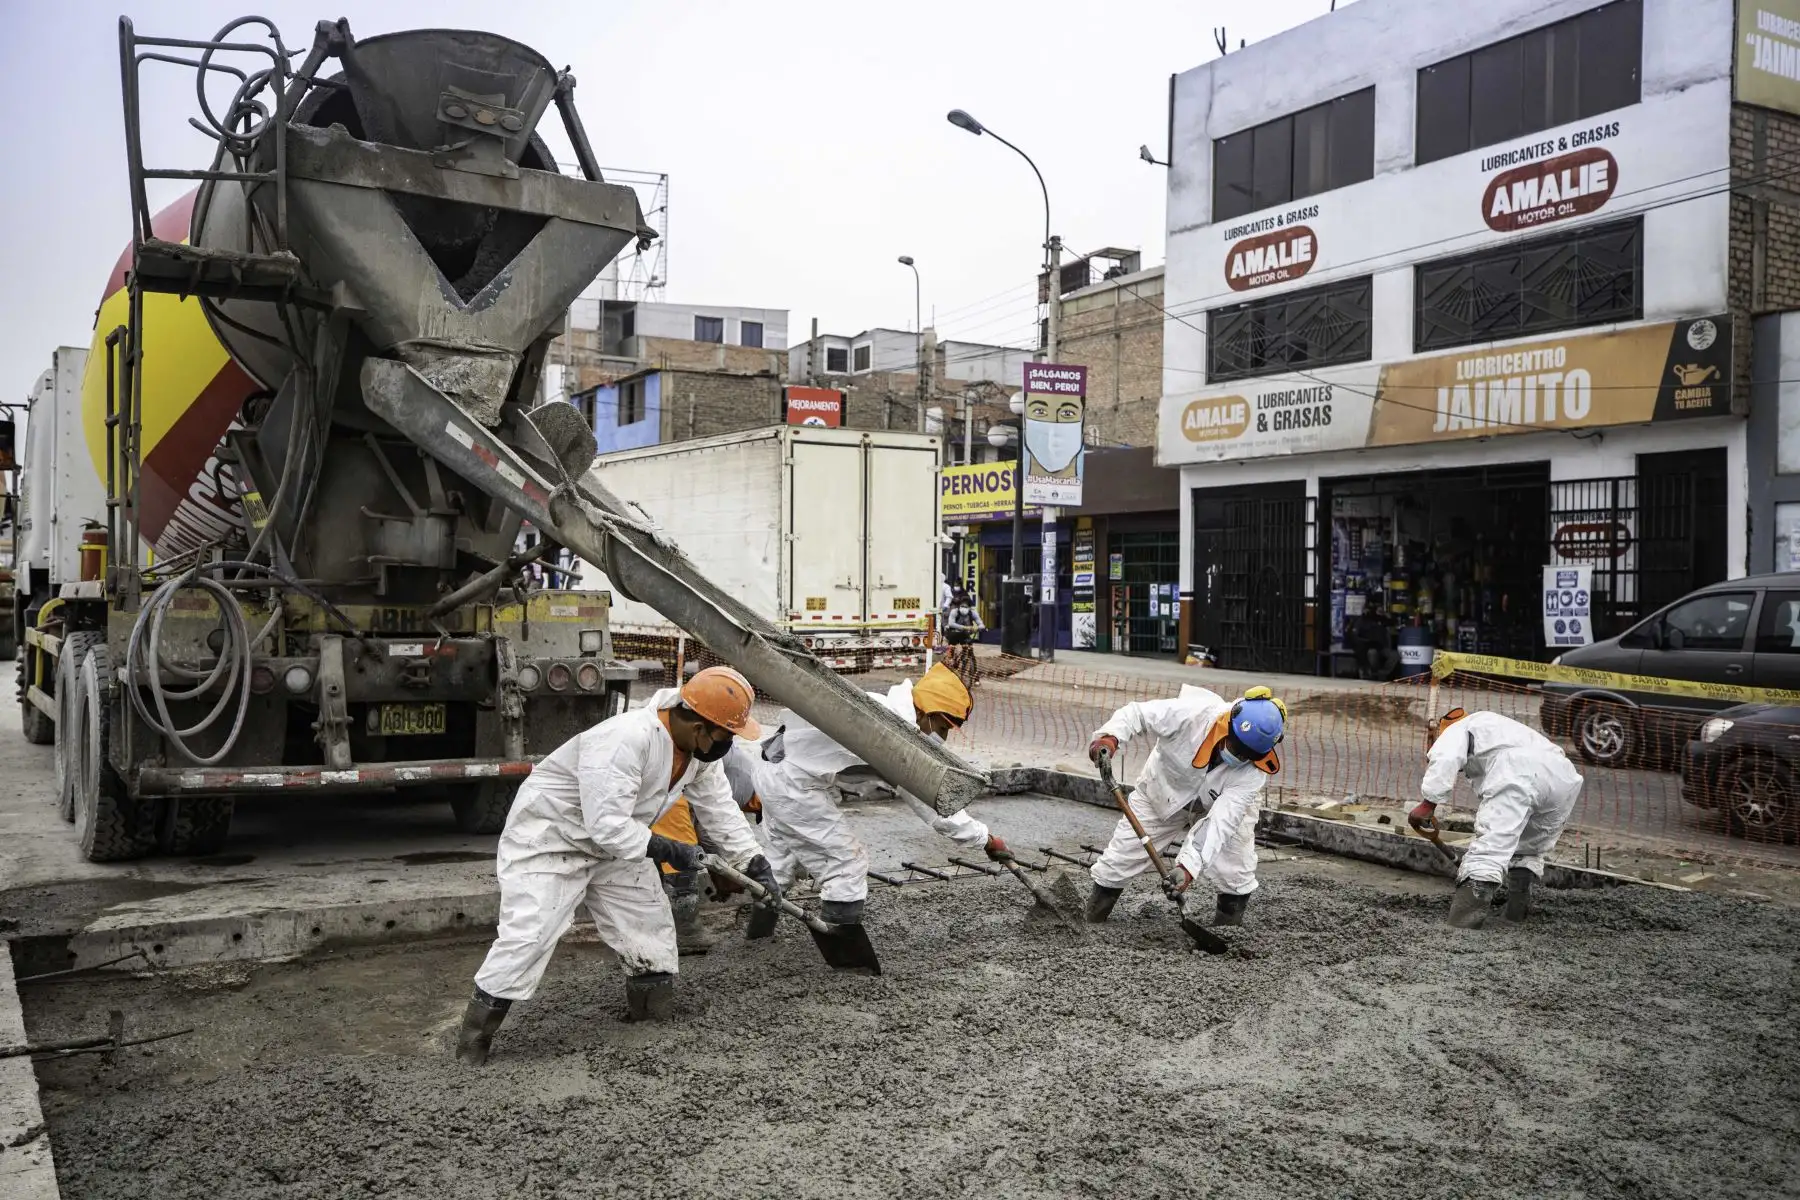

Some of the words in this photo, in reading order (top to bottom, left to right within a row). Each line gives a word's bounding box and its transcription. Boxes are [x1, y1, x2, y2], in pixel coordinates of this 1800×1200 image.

[1481, 140, 1554, 172] LUBRICANTES
[1558, 137, 1567, 151] &
[1572, 122, 1620, 147] GRASAS
[1490, 159, 1609, 218] AMALIE
[1224, 217, 1274, 241] LUBRICANTES
[1277, 215, 1284, 226] &
[1286, 205, 1319, 224] GRASAS
[1518, 206, 1556, 224] MOTOR
[1558, 202, 1576, 215] OIL
[1230, 235, 1312, 279] AMALIE
[1249, 273, 1275, 286] MOTOR
[1277, 270, 1290, 280] OIL
[1029, 369, 1081, 380] ¡SALGAMOS
[1456, 346, 1566, 380] LUBRICENTRO
[1030, 381, 1053, 391] BIEN,
[1055, 381, 1079, 392] PERÚ!
[1257, 384, 1332, 409] LUBRICANTES
[789, 399, 840, 411] MEJORAMIENTO
[1433, 368, 1591, 432] JAIMITO
[1185, 404, 1245, 429] AMALIE
[1257, 413, 1268, 432] &
[1273, 405, 1332, 431] GRASAS
[943, 503, 962, 511] PERNOS
[966, 501, 990, 509] TUERCAS
